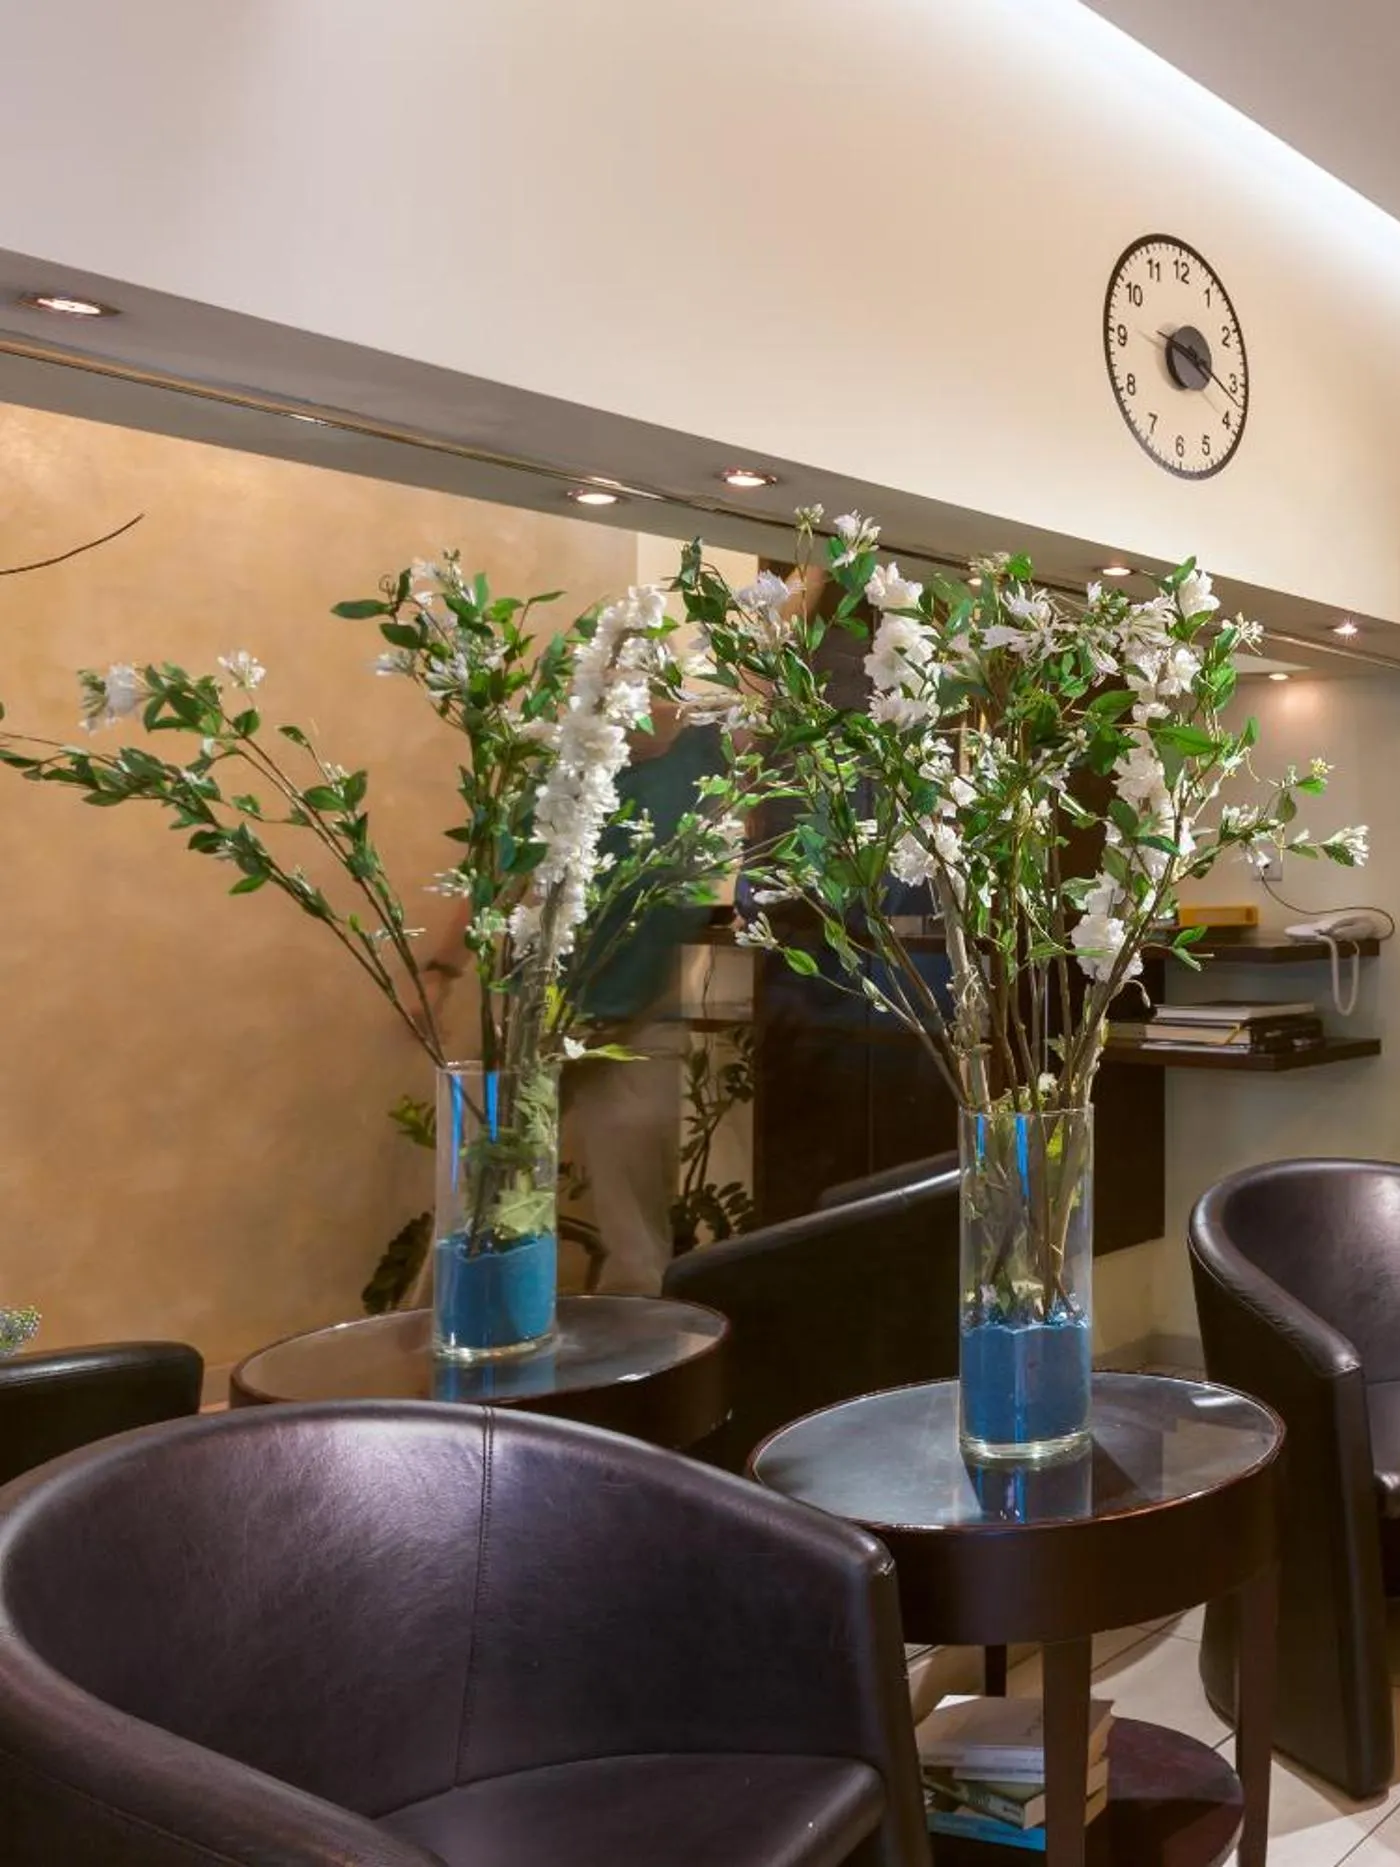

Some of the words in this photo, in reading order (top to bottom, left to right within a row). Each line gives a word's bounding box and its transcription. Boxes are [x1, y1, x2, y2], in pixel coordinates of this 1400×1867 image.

[1147, 259, 1162, 282] 11
[1173, 259, 1190, 284] 12
[1125, 282, 1143, 307] 10
[1204, 289, 1211, 308] 1
[1117, 324, 1128, 347] 9
[1221, 326, 1231, 348] 2
[1127, 373, 1136, 396] 8
[1229, 373, 1238, 394] 3
[1148, 412, 1158, 434] 7
[1222, 411, 1231, 430] 4
[1175, 436, 1185, 457] 6
[1202, 436, 1211, 456] 5
